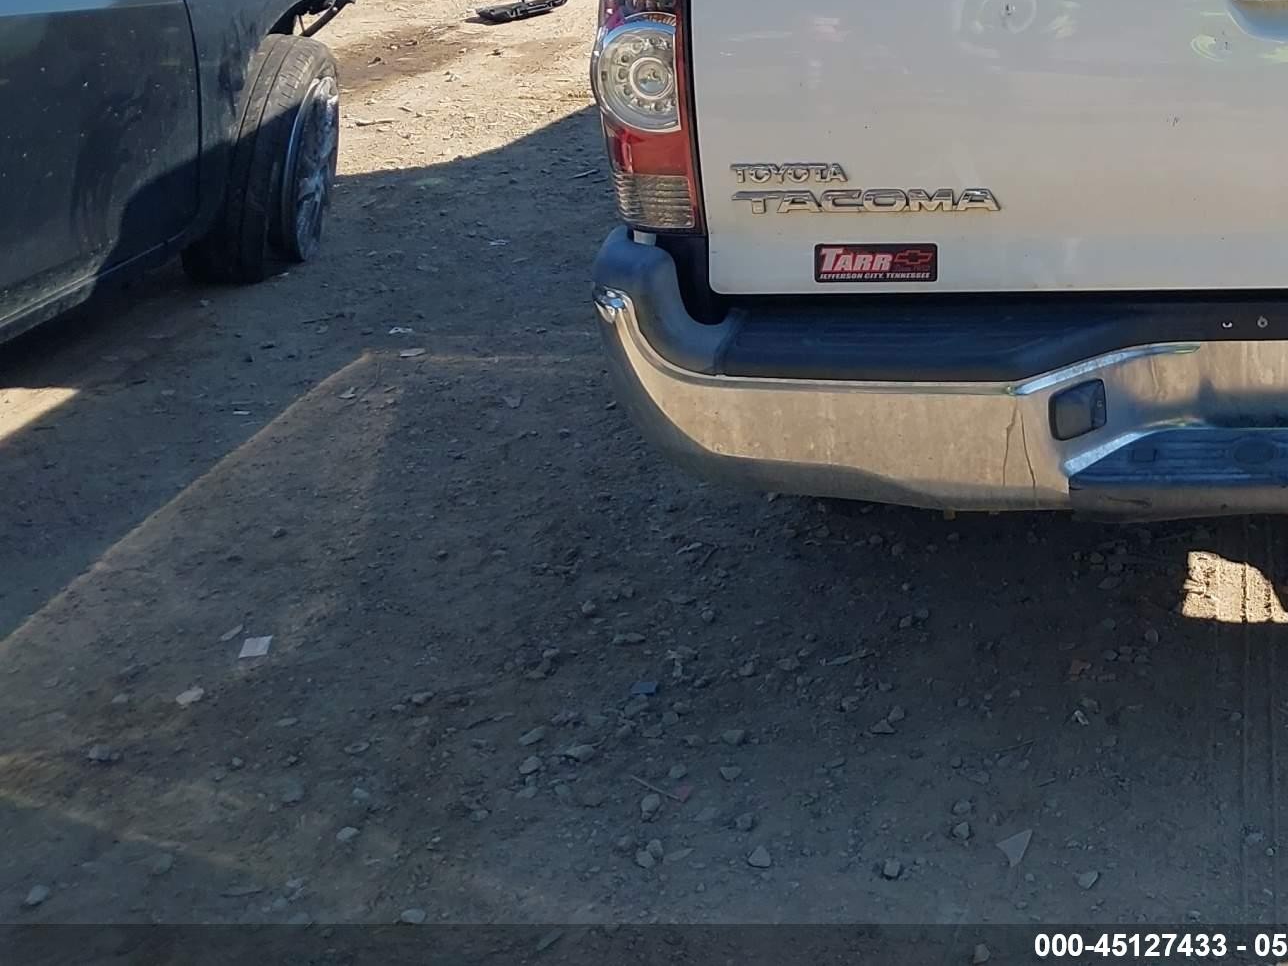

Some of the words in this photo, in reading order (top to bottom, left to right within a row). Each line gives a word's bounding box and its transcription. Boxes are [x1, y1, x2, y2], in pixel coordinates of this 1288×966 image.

[730, 162, 848, 184] TOYOTA
[731, 187, 1001, 215] TACOMA
[820, 247, 893, 272] TARR
[820, 272, 863, 280] JEFFERSON
